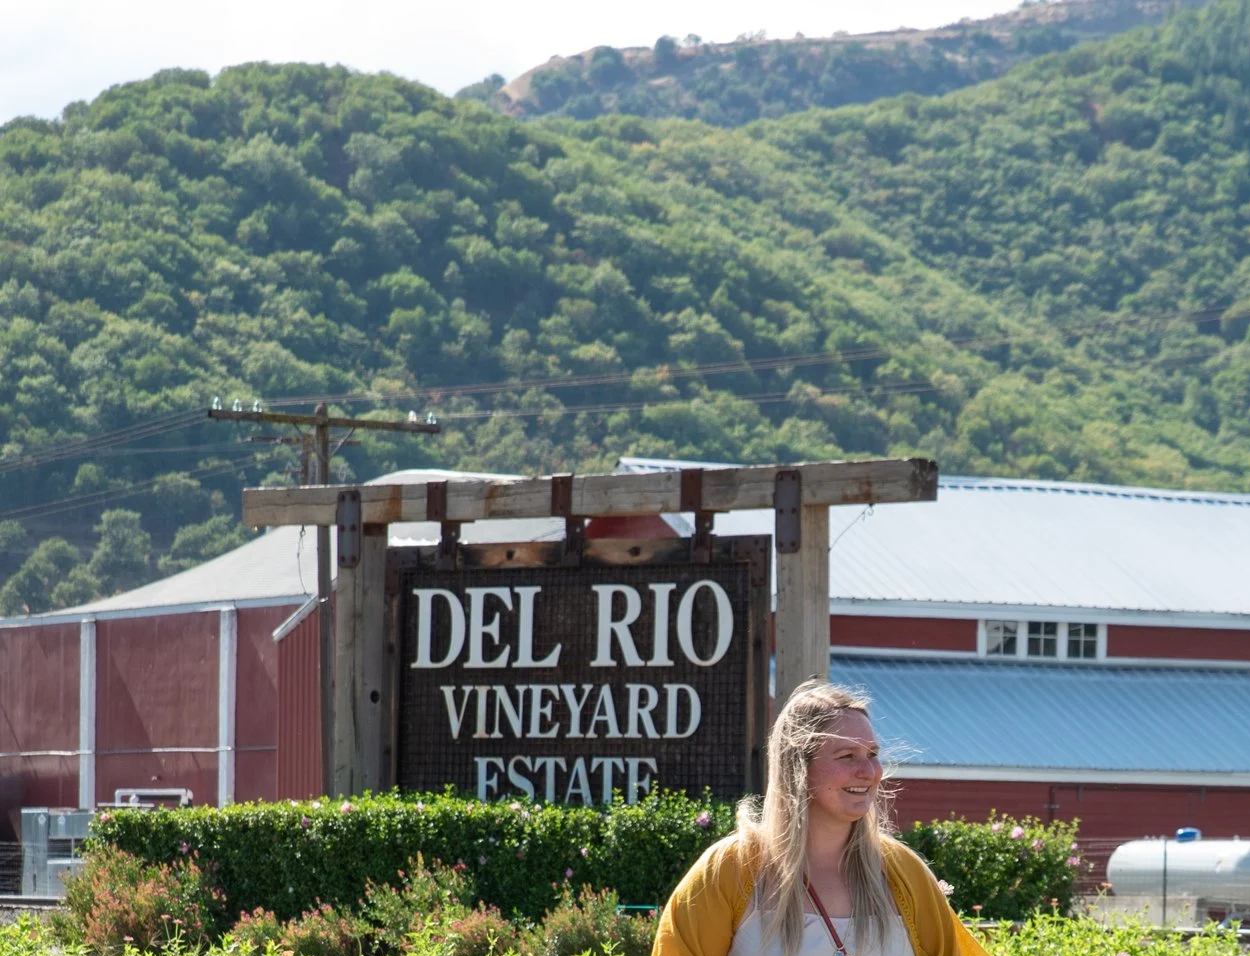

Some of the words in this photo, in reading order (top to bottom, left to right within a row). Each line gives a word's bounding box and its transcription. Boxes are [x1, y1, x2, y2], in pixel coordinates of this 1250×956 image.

[410, 585, 562, 669] DEL
[590, 579, 734, 667] RIO
[440, 683, 702, 740] VINEYARD
[474, 755, 659, 806] ESTATE
